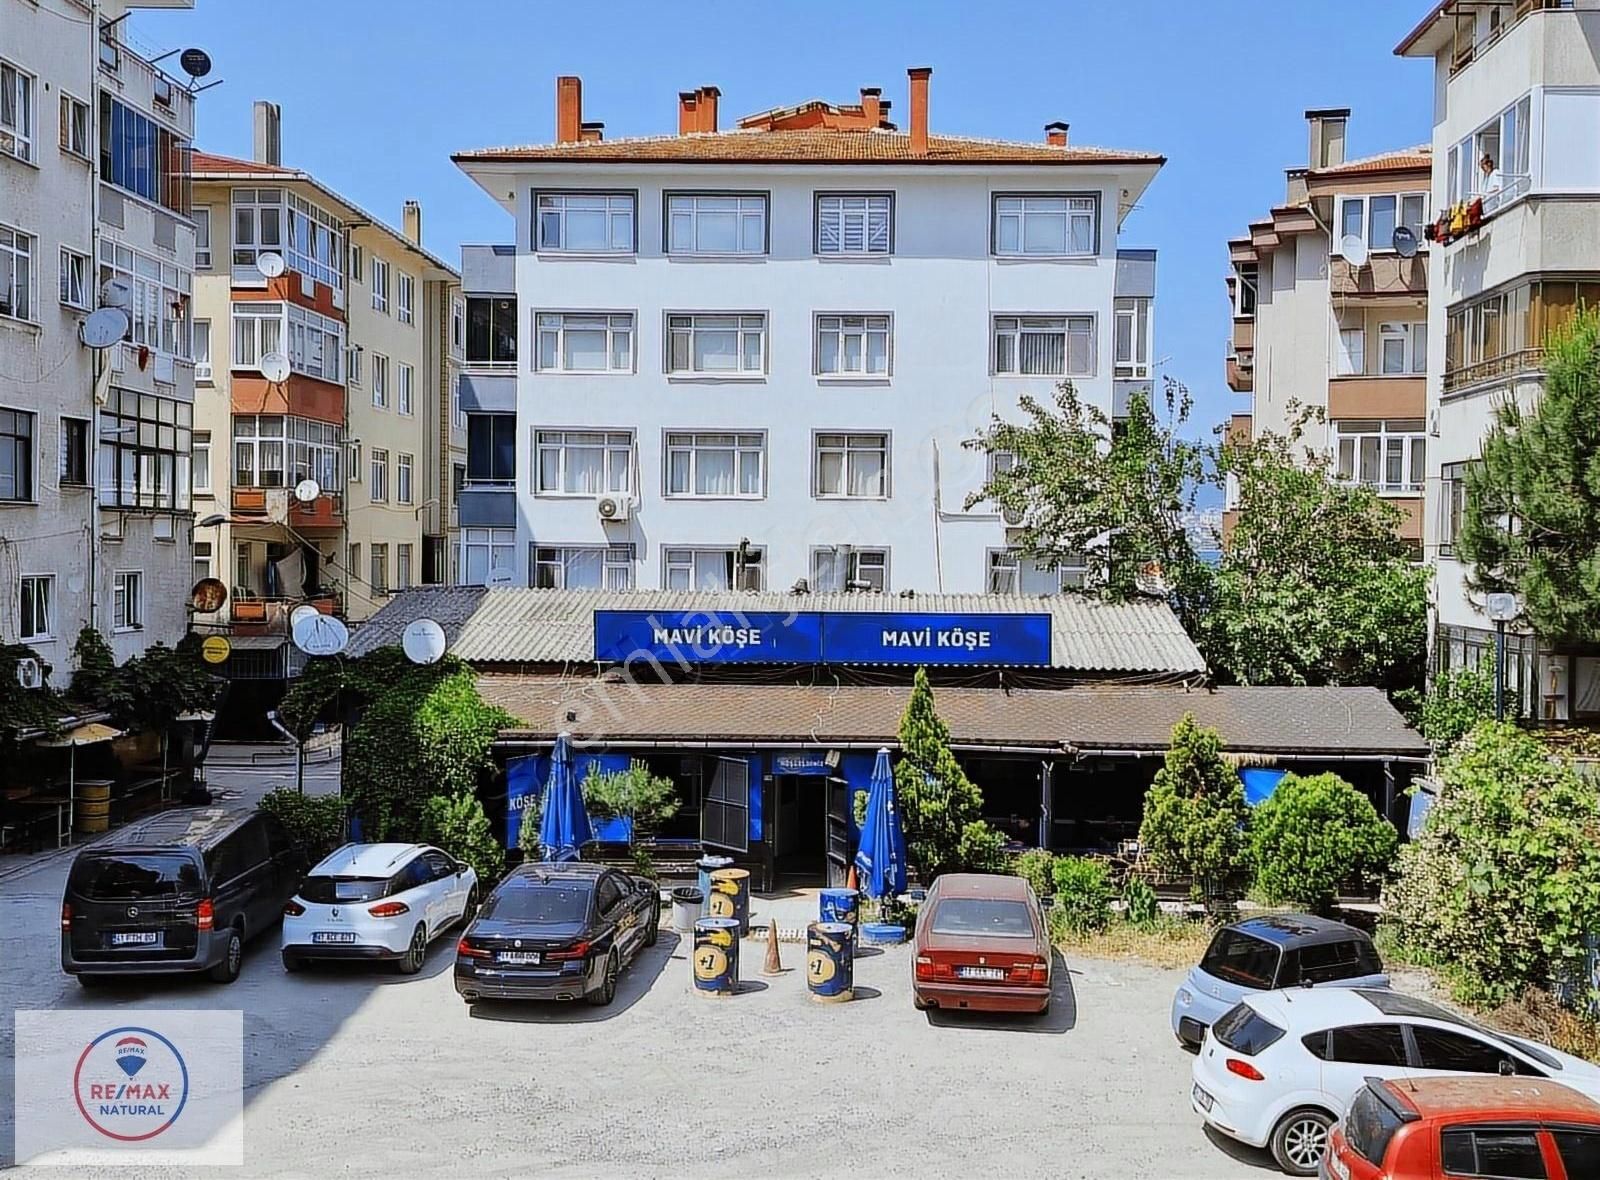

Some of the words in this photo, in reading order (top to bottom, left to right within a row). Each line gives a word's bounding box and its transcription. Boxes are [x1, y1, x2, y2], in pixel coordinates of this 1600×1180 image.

[653, 626, 701, 645] MAVİ
[708, 626, 761, 649] KÖŞE
[882, 627, 931, 647] MAVİ
[937, 627, 991, 651] KÖŞE
[699, 954, 715, 970] +1
[809, 960, 822, 975] +1
